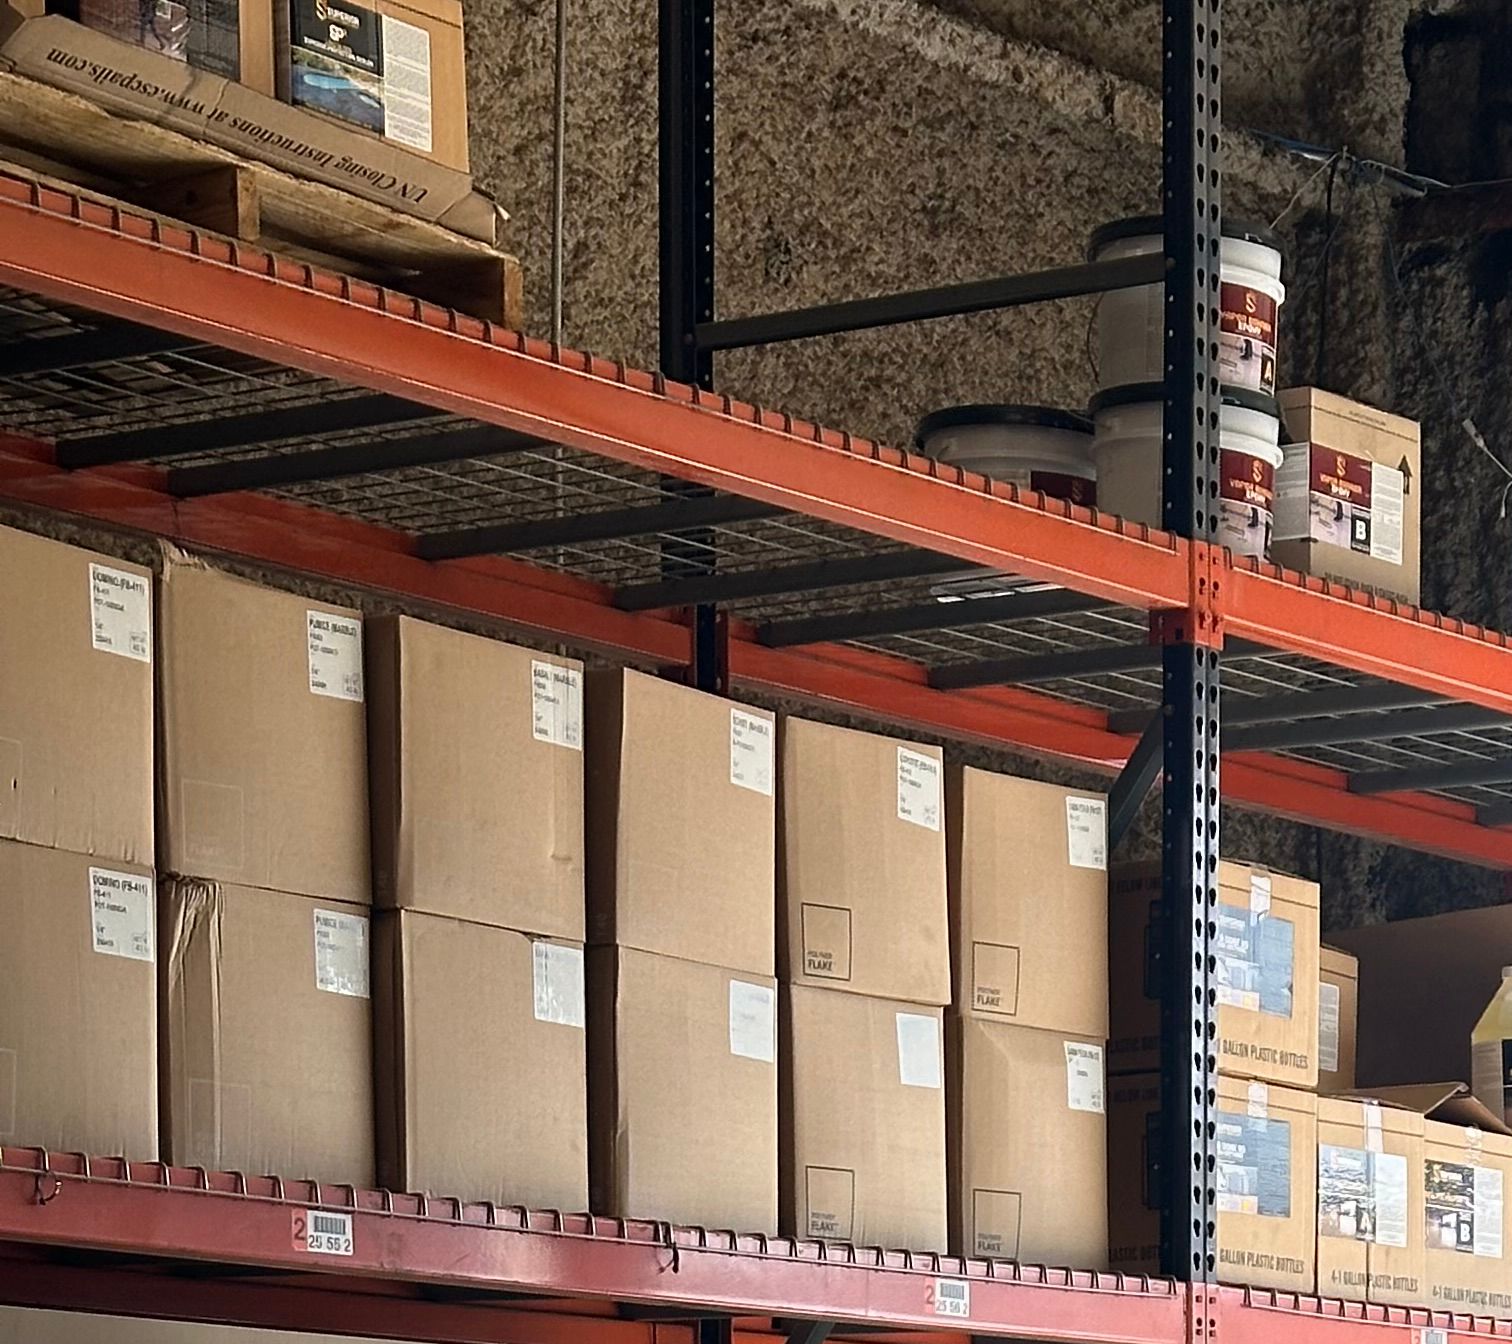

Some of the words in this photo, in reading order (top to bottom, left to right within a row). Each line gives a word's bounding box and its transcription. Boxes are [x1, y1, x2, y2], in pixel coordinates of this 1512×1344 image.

[46, 48, 206, 115] www.cscpails.com
[207, 108, 229, 124] at
[229, 112, 334, 167] Instructions
[334, 157, 397, 190] Closing
[401, 183, 429, 204] UN
[1264, 360, 1273, 381] A
[1355, 519, 1367, 541] B
[294, 1217, 305, 1240] 2
[1460, 1223, 1471, 1242] B
[344, 1239, 351, 1252] 2
[1220, 1248, 1246, 1266] GALLON
[1248, 1252, 1274, 1270] PLASTIC
[1275, 1256, 1304, 1274] BOTTLES
[925, 1285, 934, 1304] 2
